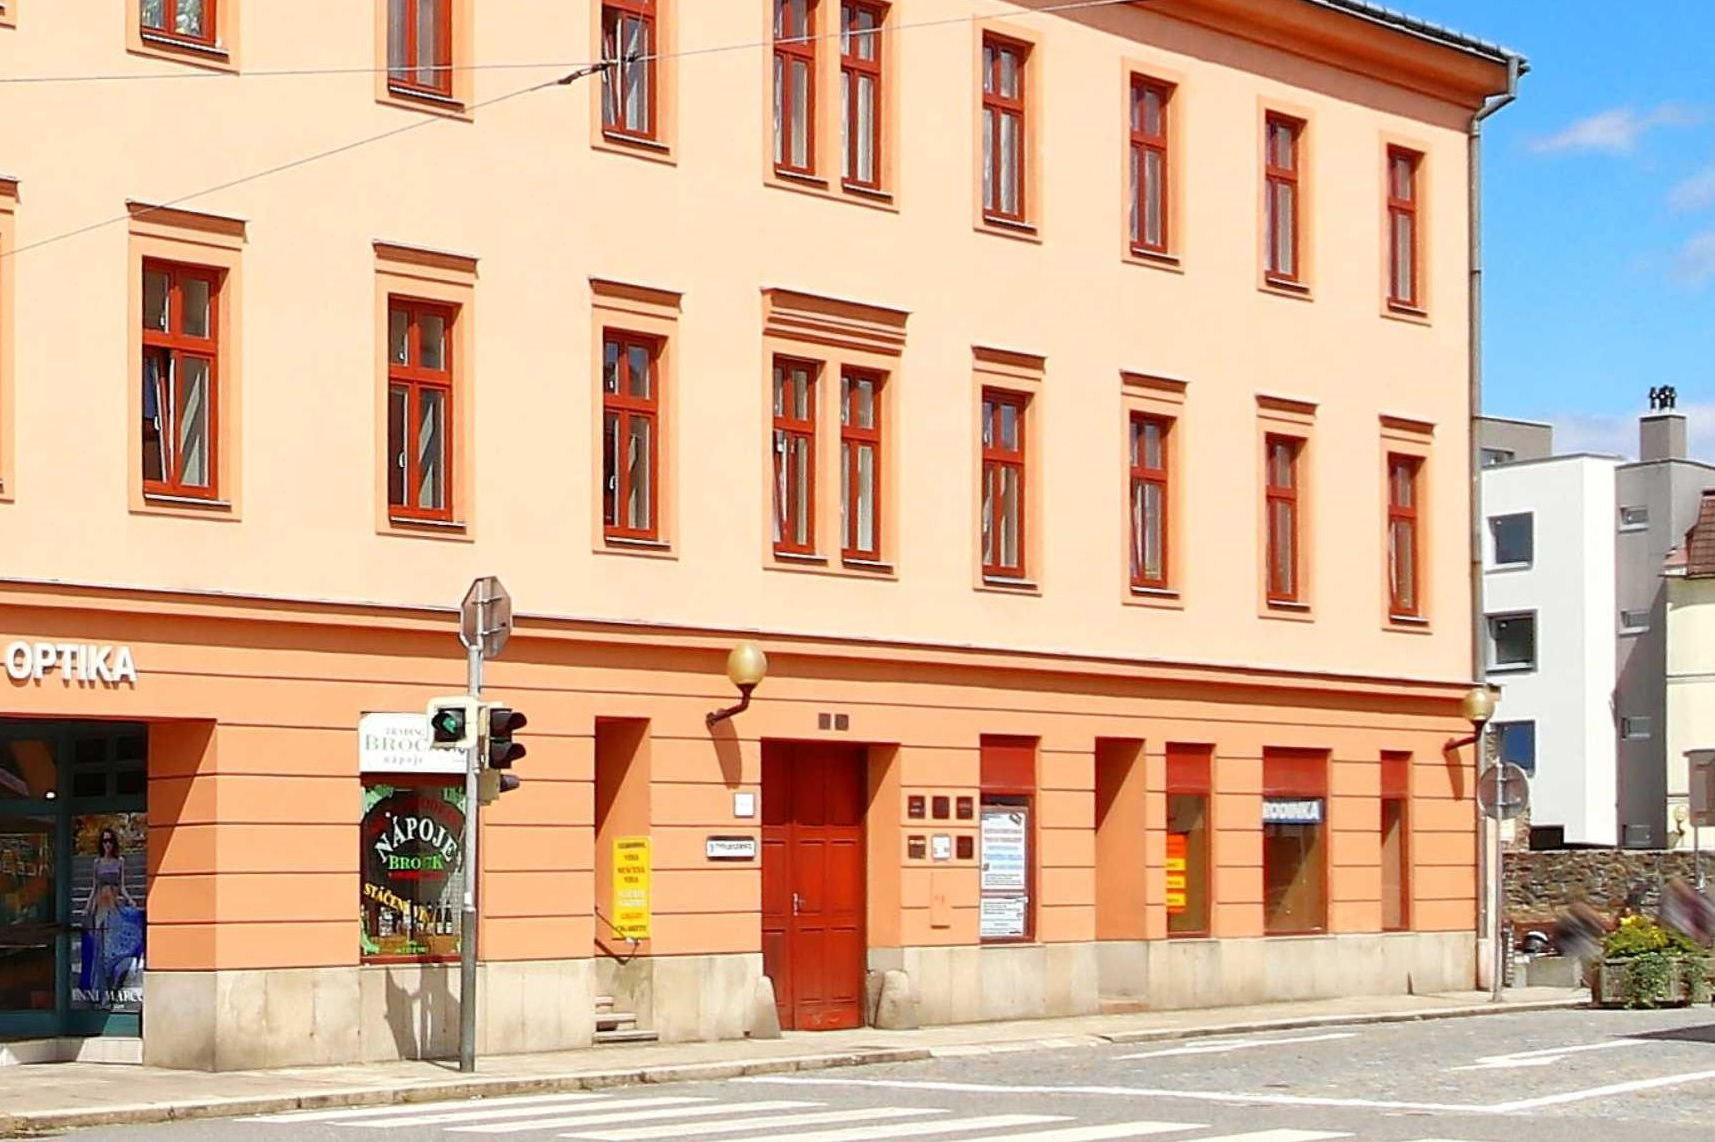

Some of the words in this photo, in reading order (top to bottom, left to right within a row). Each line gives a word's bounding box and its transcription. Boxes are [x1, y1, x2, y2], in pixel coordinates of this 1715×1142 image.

[6, 640, 137, 683] OPTIKA
[374, 815, 458, 864] NÁPOJE
[389, 854, 444, 870] BROCK
